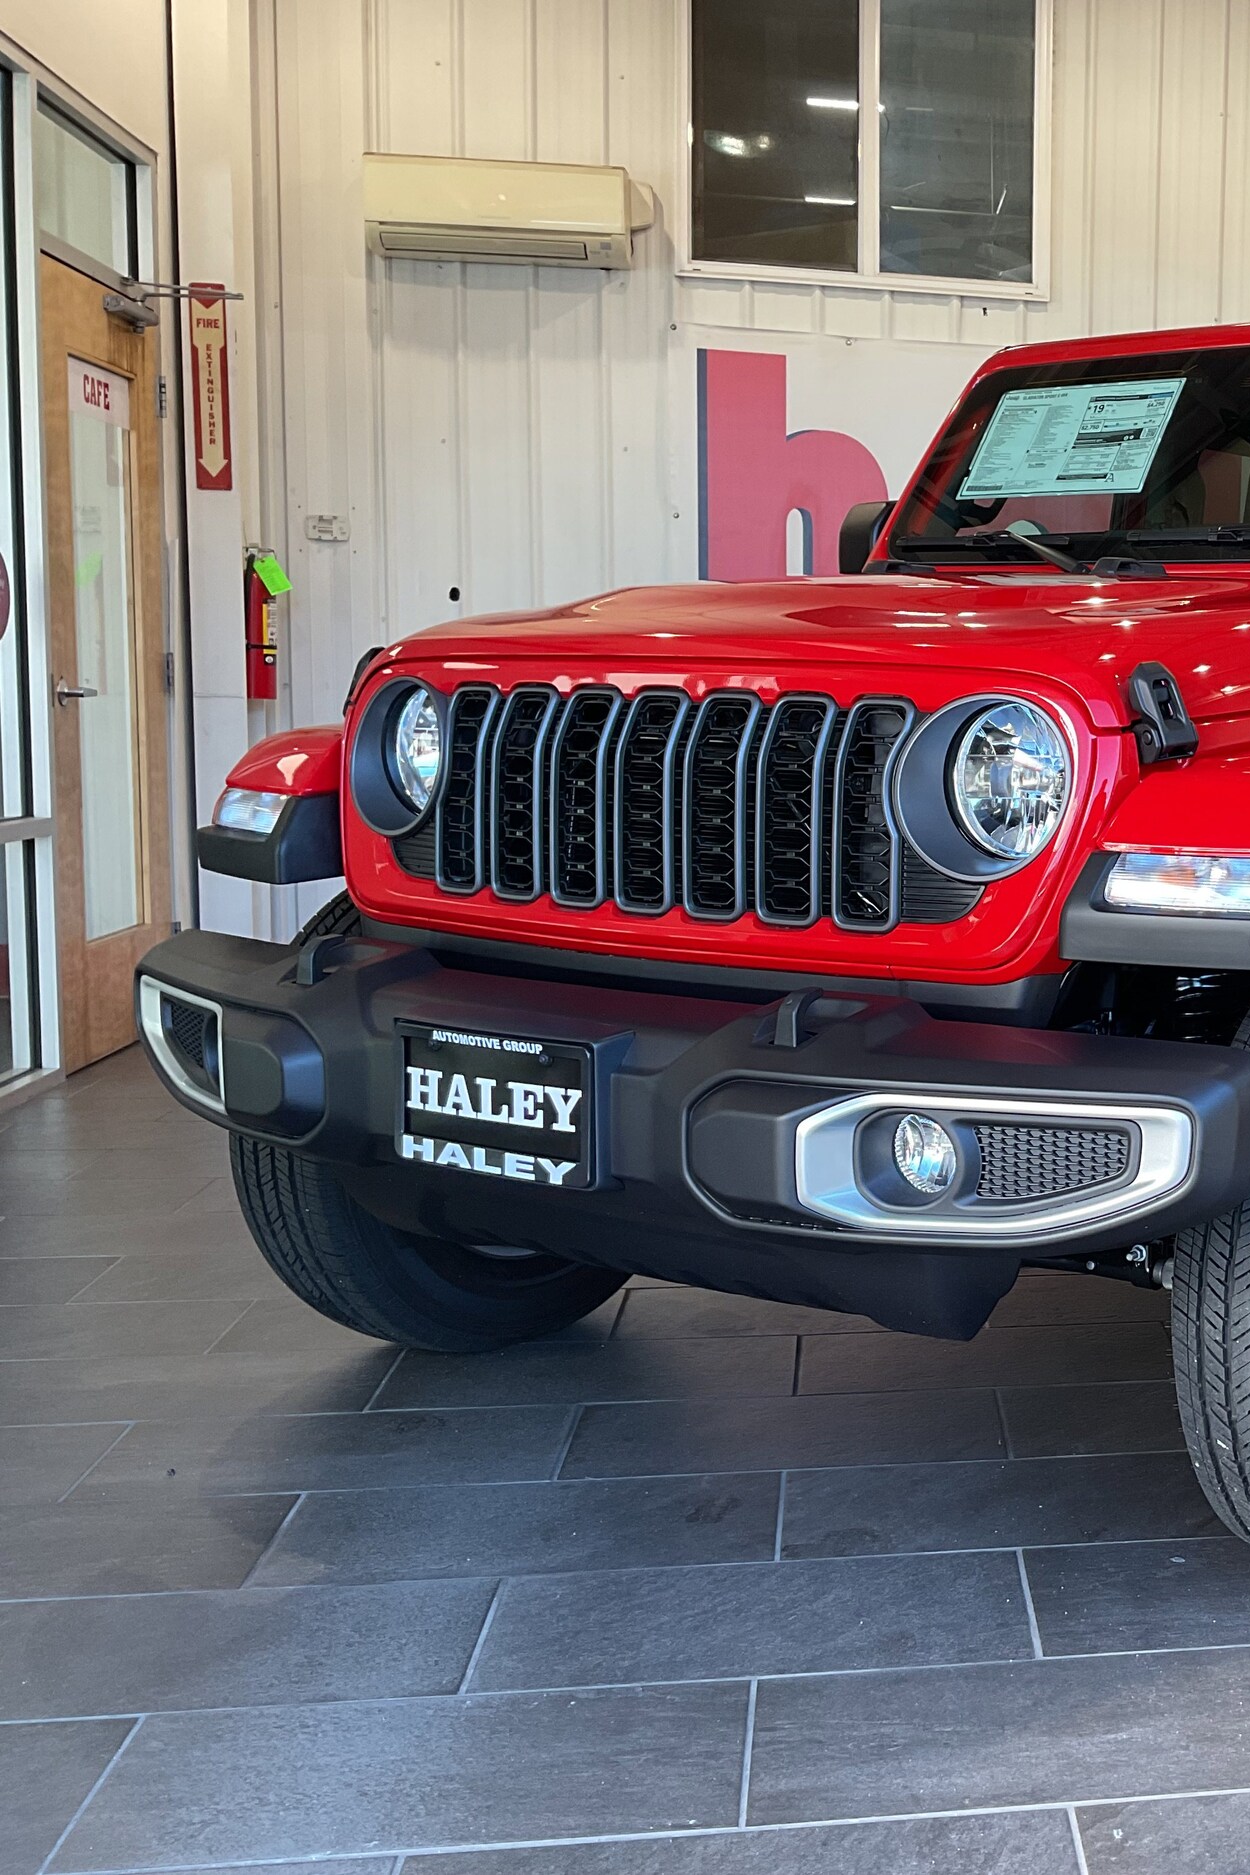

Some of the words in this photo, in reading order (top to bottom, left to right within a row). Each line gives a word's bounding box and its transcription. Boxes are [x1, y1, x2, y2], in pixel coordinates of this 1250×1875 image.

[196, 318, 220, 329] FIRE
[83, 373, 110, 411] CAFE
[205, 343, 216, 446] EXTINGUISHER
[1093, 404, 1105, 414] 19
[432, 1029, 501, 1050] AUTOMOTIVE
[502, 1041, 543, 1055] GROUP
[406, 1065, 583, 1133] HALEY
[402, 1134, 577, 1185] HALEY
